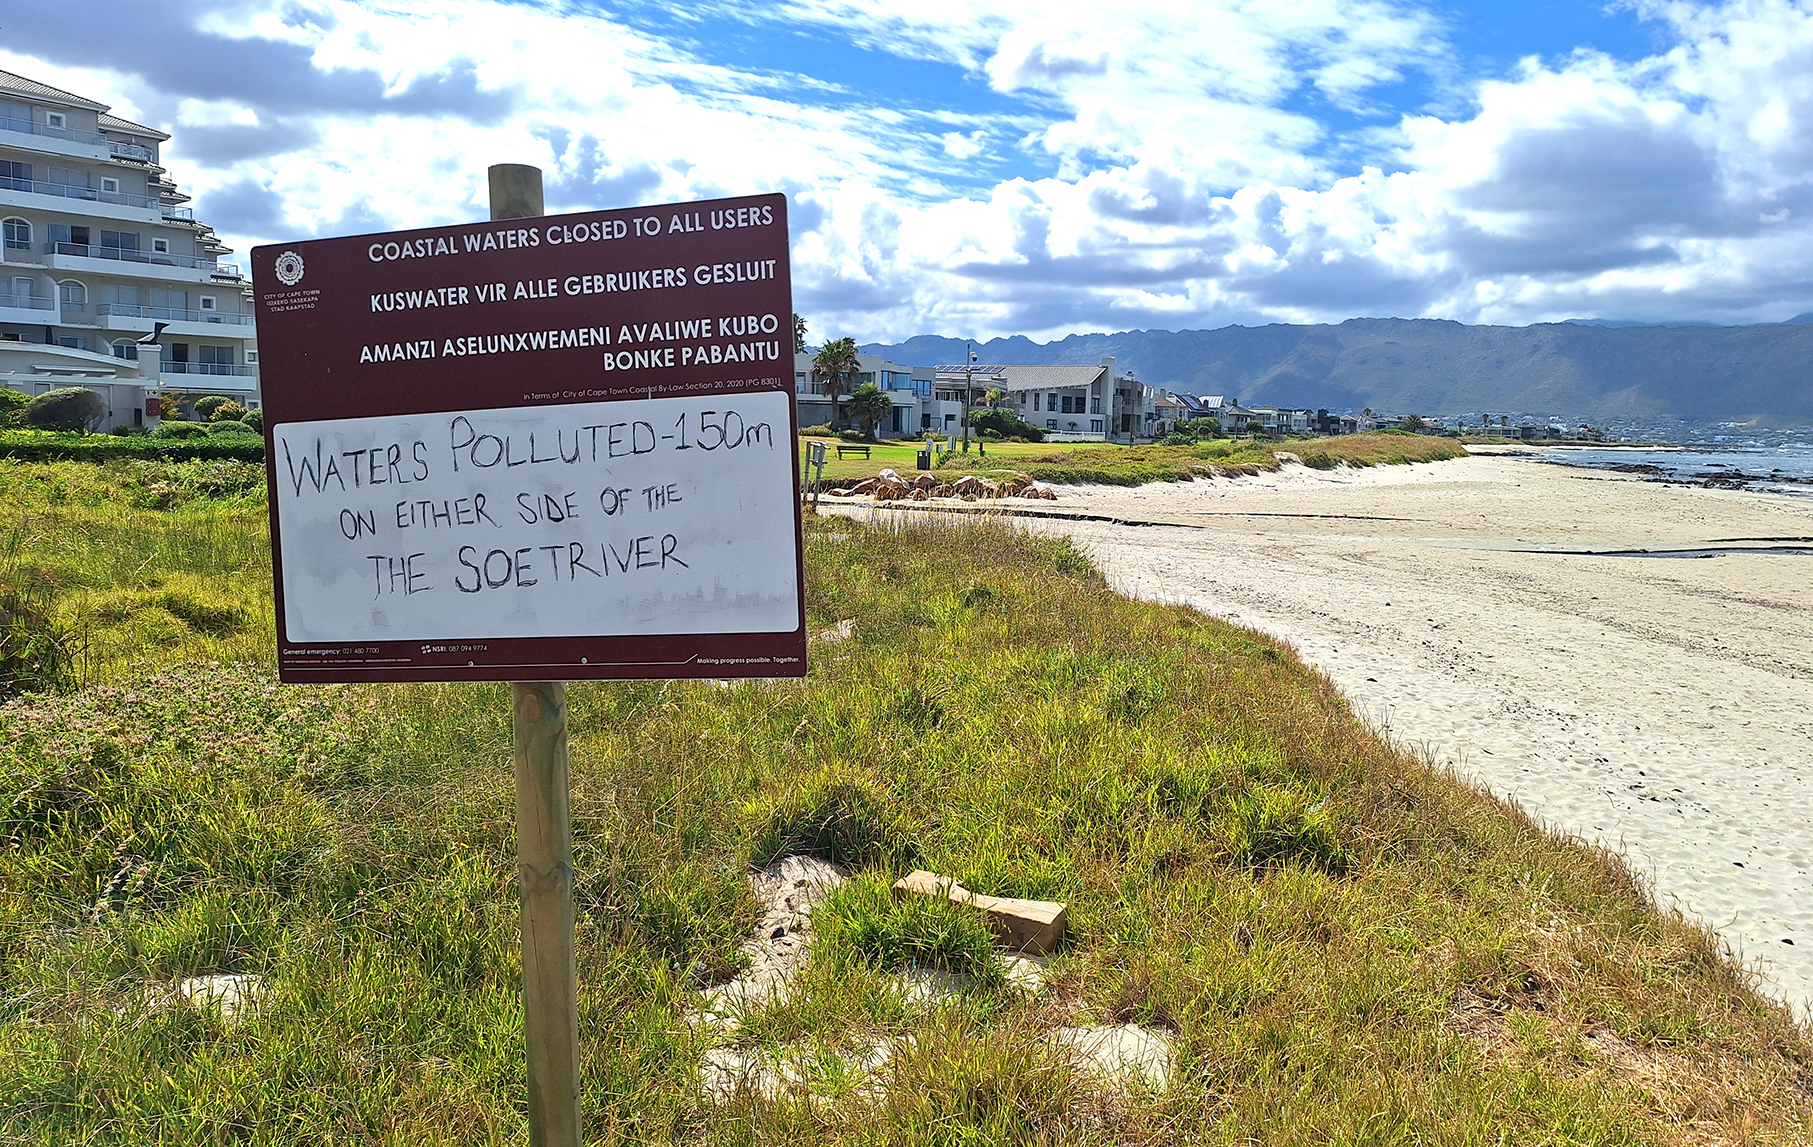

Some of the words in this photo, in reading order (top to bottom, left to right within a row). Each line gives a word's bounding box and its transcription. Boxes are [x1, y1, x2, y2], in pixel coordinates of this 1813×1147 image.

[368, 237, 459, 263] COASTAL
[463, 228, 540, 254] WATERS
[546, 218, 627, 246] CLOSED
[633, 216, 661, 238] TO
[667, 211, 704, 234] ALL
[710, 205, 773, 230] USERS
[286, 303, 315, 311] KAAPSTAD
[370, 287, 469, 313] KUSWATER
[474, 283, 507, 304] VIR
[513, 278, 558, 301] ALLE
[563, 266, 687, 298] GEBRUIKERS
[693, 259, 777, 286] GESLUIT
[359, 340, 436, 364] AMANZI
[441, 326, 610, 358] ASELUNXWEMENI
[617, 318, 712, 344] AVALIWE
[719, 313, 779, 337] KUBO
[603, 348, 675, 371] BONKE
[681, 341, 780, 368] PABANTU
[531, 392, 551, 400] Terms
[552, 391, 560, 399] of
[562, 390, 576, 399] City
[578, 389, 586, 397] of
[587, 388, 608, 397] Cape
[609, 387, 628, 395] Town
[629, 385, 658, 394] Coastal
[658, 384, 684, 393] By-Law
[686, 381, 713, 390] Section
[726, 379, 744, 387] 2020
[745, 378, 760, 388] (PG
[280, 436, 429, 498] WATERS
[339, 507, 377, 541] ON
[396, 492, 503, 531] EITHER
[516, 490, 580, 525] SIDE
[600, 486, 632, 516] OF
[641, 483, 683, 512] THE
[366, 551, 435, 602] THE
